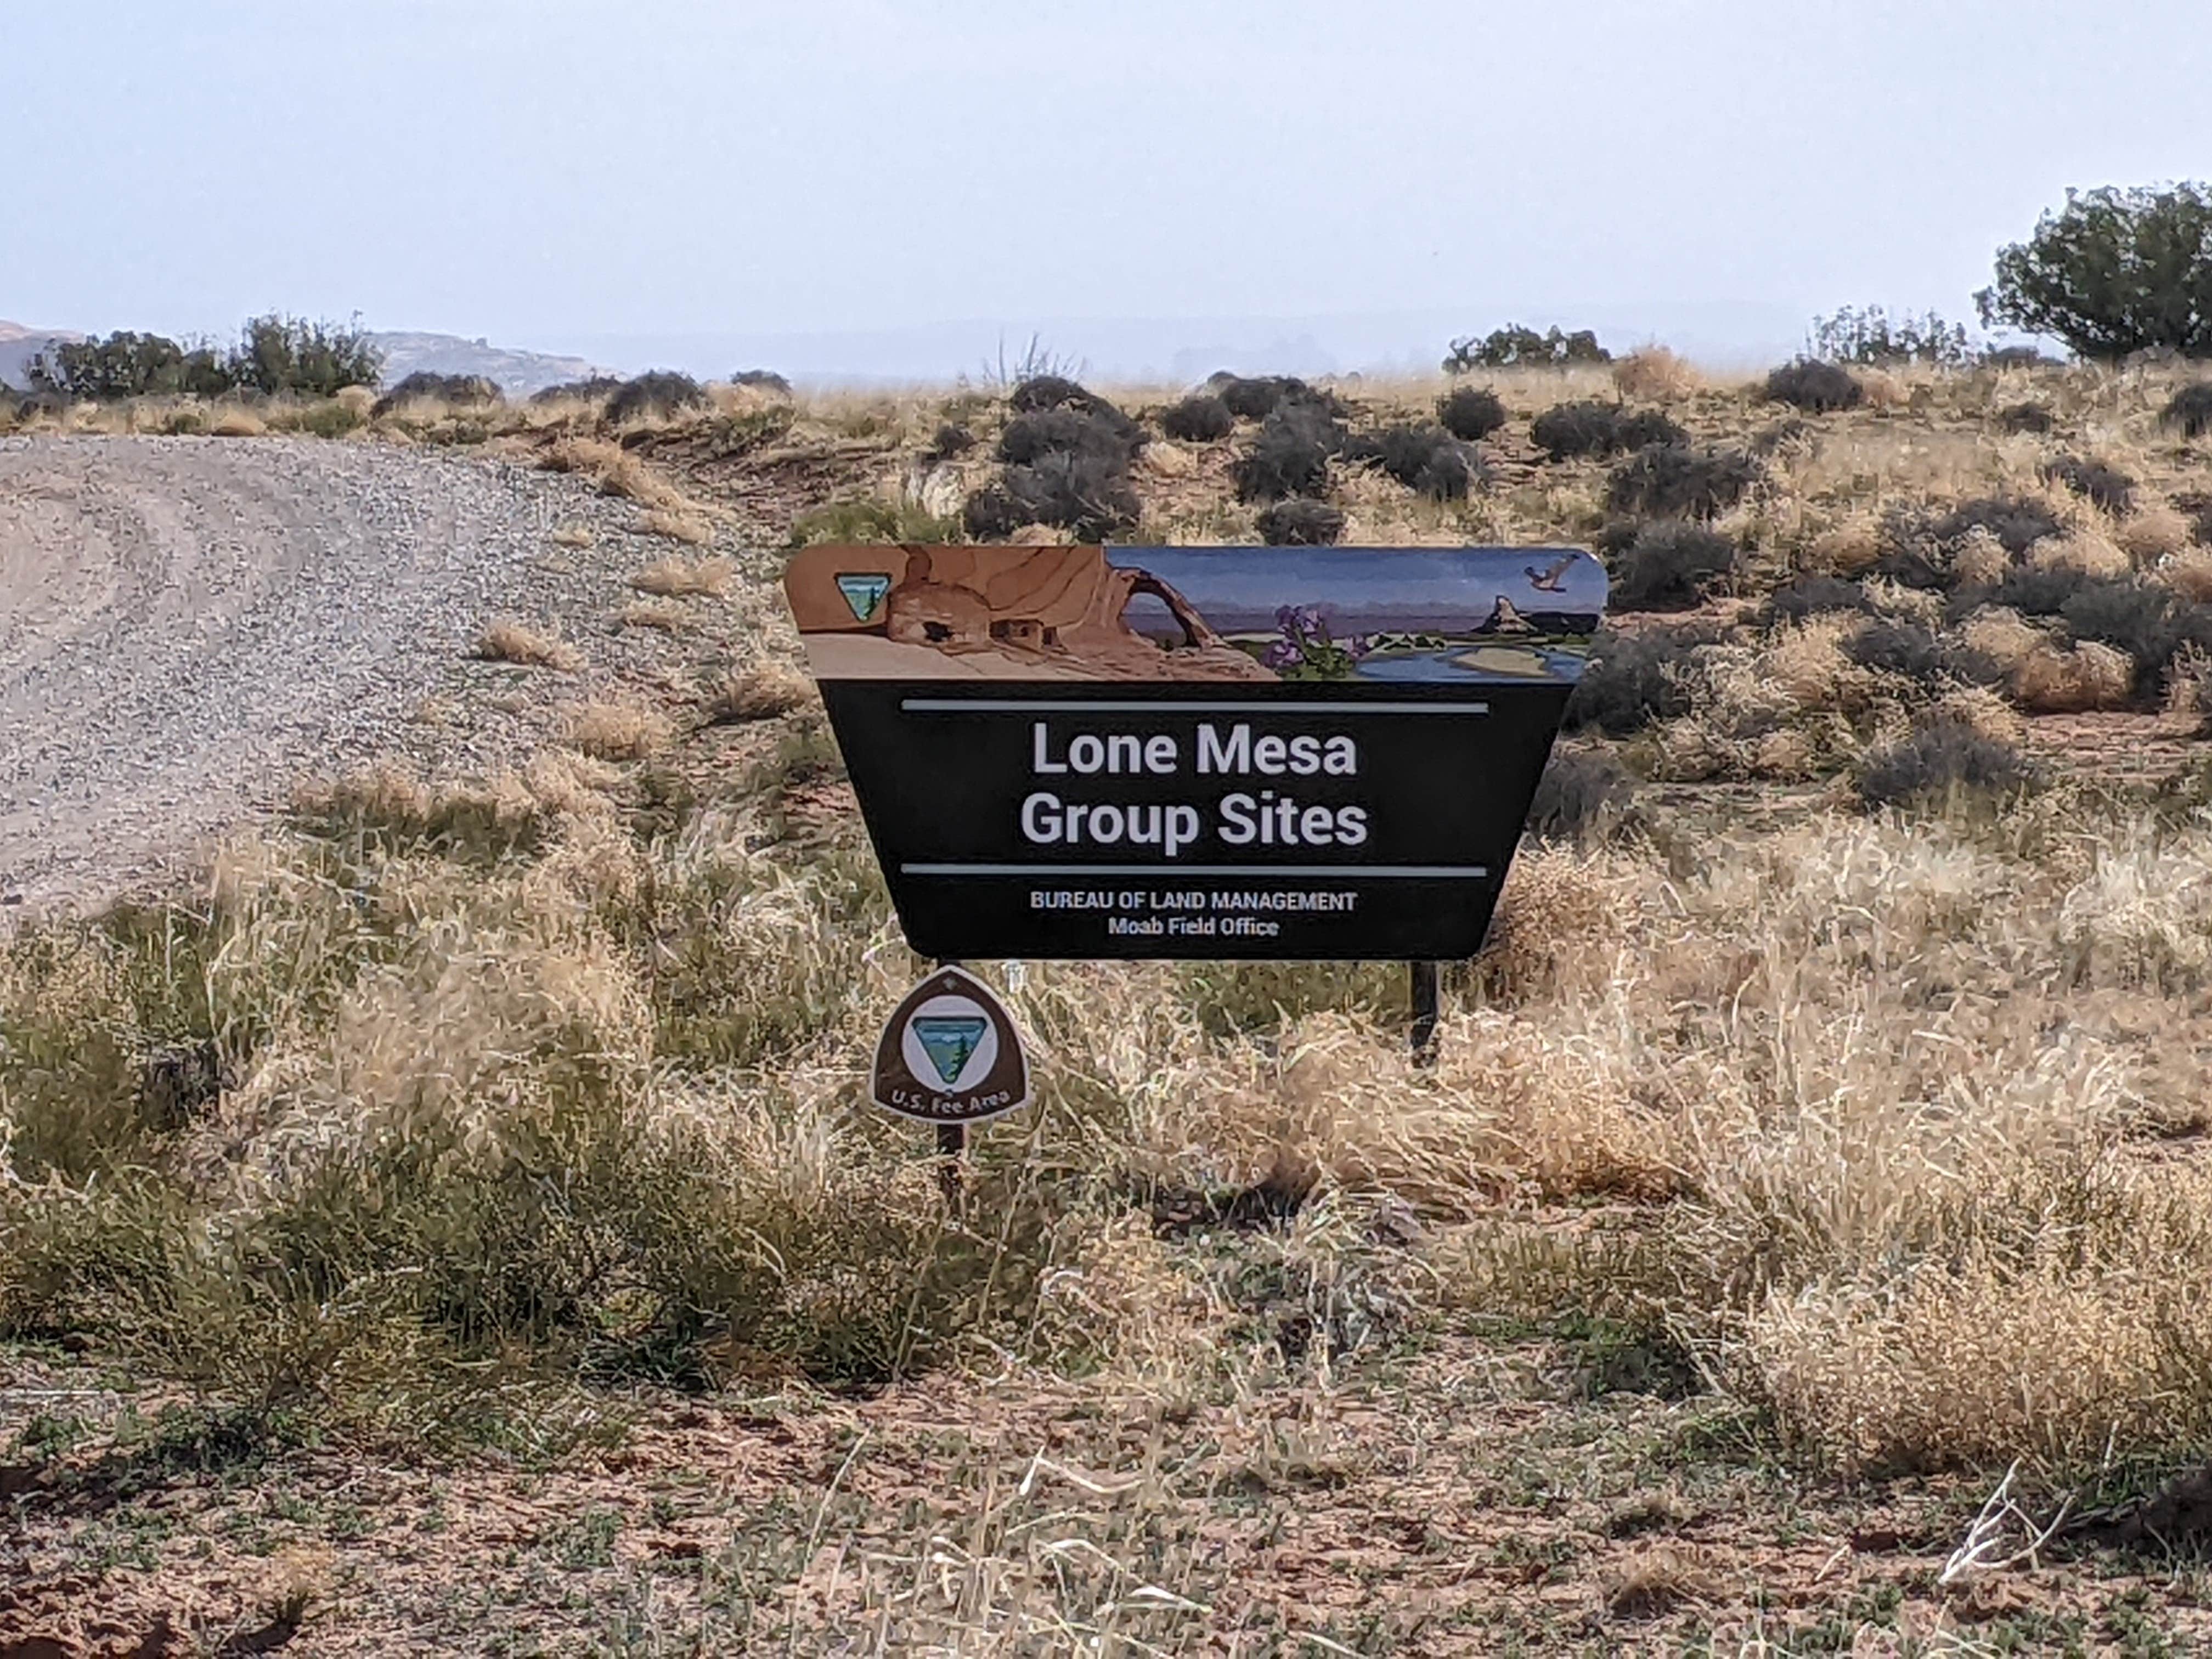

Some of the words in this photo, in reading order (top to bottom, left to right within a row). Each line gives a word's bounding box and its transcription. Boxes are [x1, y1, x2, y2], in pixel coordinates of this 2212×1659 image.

[1035, 723, 1177, 772] Lone
[1198, 724, 1356, 775] Mesa
[1022, 793, 1198, 856] Group
[1218, 791, 1367, 844] Sites
[1031, 891, 1113, 908] BUREAU
[1119, 892, 1146, 909] OF
[1151, 892, 1205, 909] LAND
[1212, 892, 1357, 910] MANAGEMENT
[1109, 916, 1163, 934] Moab
[1169, 917, 1215, 934] Field
[1221, 917, 1279, 935] Office
[891, 1089, 925, 1110] U.S.
